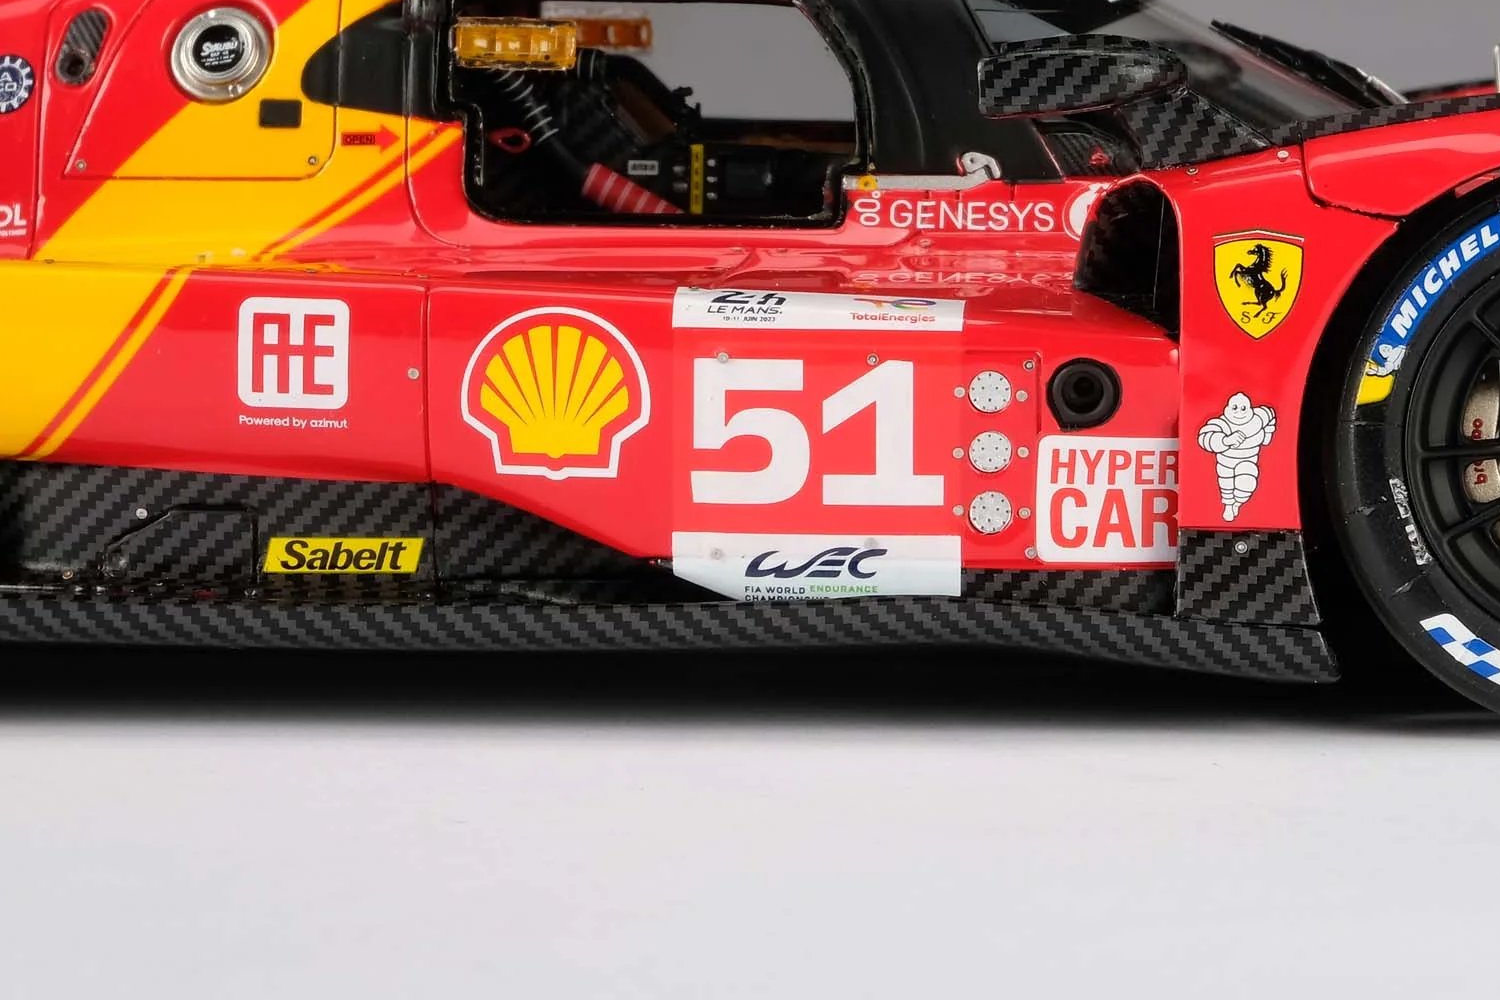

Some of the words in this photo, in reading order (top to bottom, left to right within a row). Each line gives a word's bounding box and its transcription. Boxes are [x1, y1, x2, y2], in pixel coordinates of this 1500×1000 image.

[889, 200, 1055, 232] GENESYS
[707, 305, 728, 314] LE
[850, 312, 936, 324] TotalEnergies
[239, 415, 289, 427] Powered
[292, 416, 307, 429] by
[310, 418, 348, 429] azimut
[690, 358, 945, 506] 51
[1050, 448, 1179, 485] HYPER
[1050, 487, 1179, 549] CAR
[280, 540, 407, 571] Sabelt
[744, 547, 888, 579] WEC
[744, 585, 762, 593] FIA
[765, 586, 806, 595] WORLD
[809, 584, 879, 593] ENDURANCE
